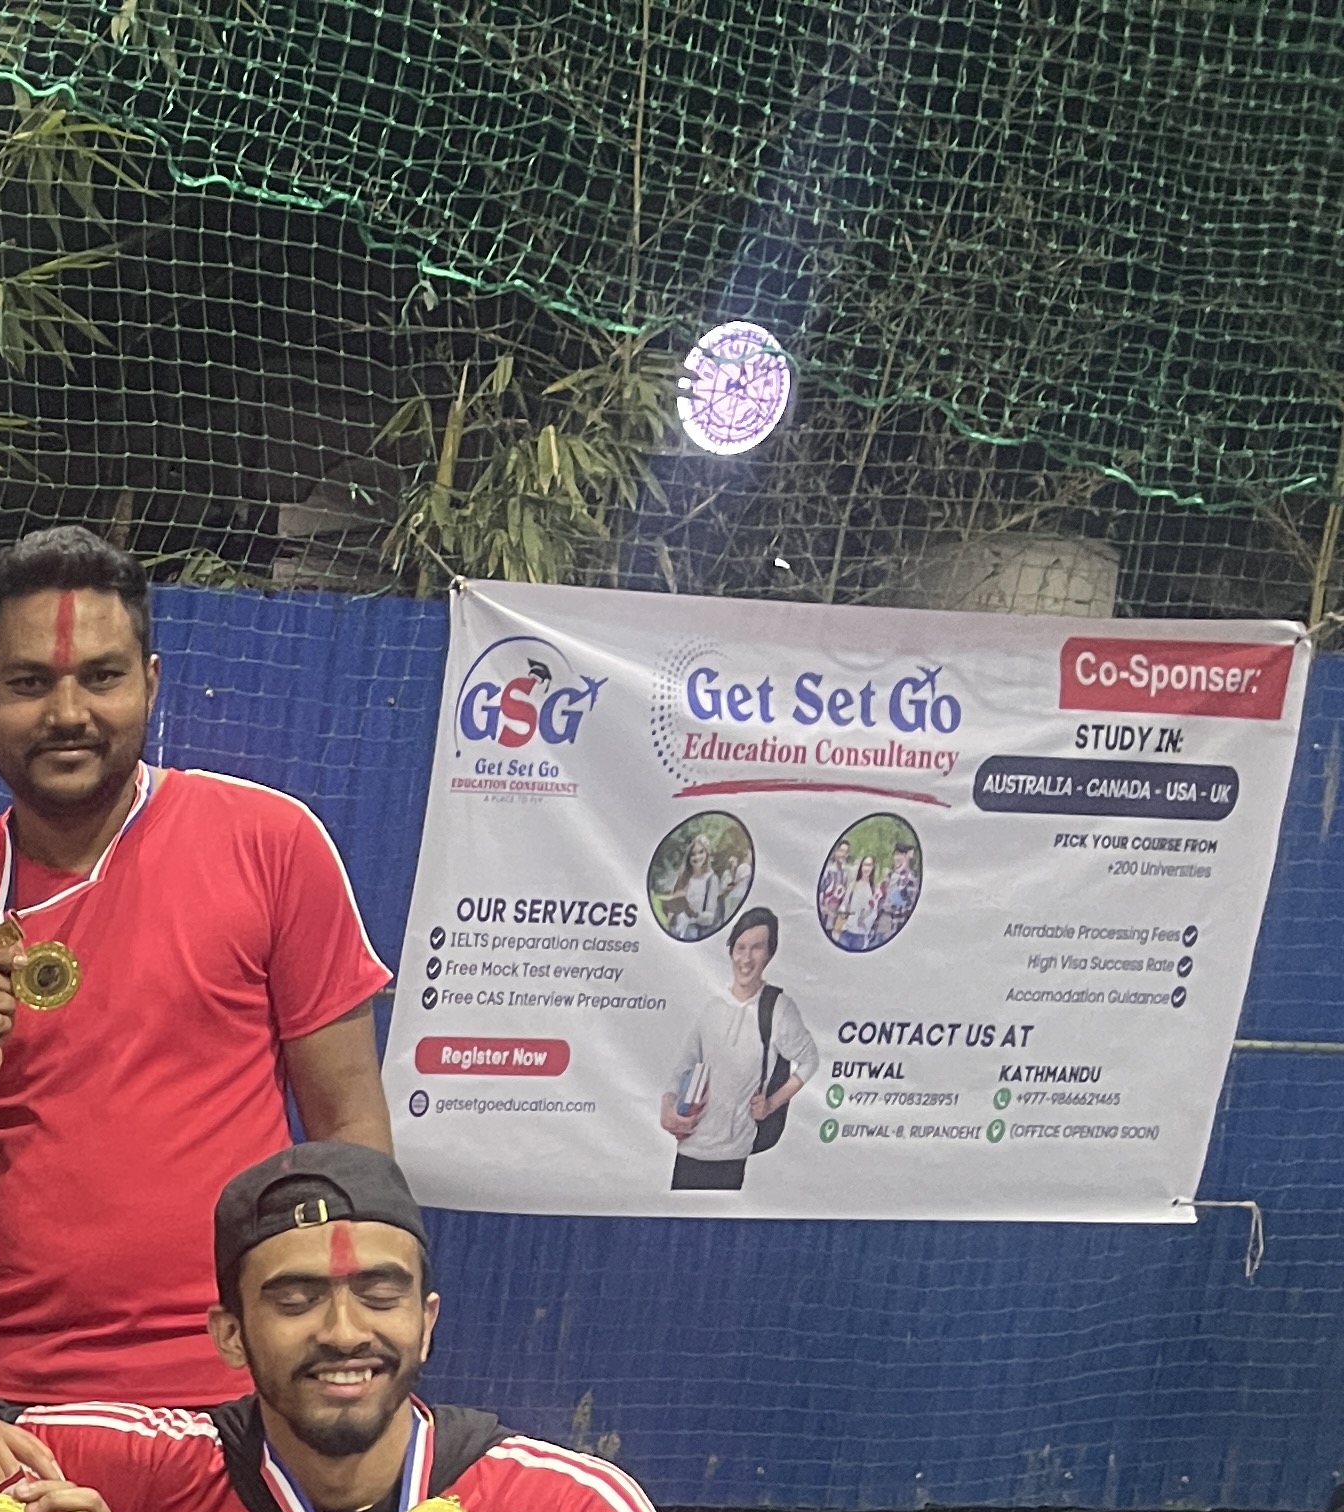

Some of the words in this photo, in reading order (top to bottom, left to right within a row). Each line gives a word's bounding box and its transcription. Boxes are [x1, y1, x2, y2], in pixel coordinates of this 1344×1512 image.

[1075, 651, 1261, 697] Co-Sponser:
[687, 667, 775, 724] Get
[792, 672, 878, 728] Set
[889, 674, 962, 734] Go
[459, 675, 590, 749] GSG
[1075, 724, 1153, 752] STUDY
[1154, 728, 1184, 753] IN:
[683, 733, 807, 764] Education
[815, 738, 959, 777] Consultancy
[475, 758, 502, 776] Get
[507, 759, 534, 777] Set
[538, 761, 560, 778] Go
[451, 778, 507, 790] EDUCATION
[982, 774, 1072, 797] AUSTRALIA
[1086, 778, 1151, 800] CANADA
[1166, 782, 1197, 802] USA
[1210, 783, 1233, 804] UK
[1054, 833, 1087, 850] PICK
[1092, 835, 1128, 851] YOUR
[1132, 837, 1181, 853] COURSE
[1184, 839, 1218, 854] FROM
[1107, 861, 1139, 877] +200
[456, 897, 506, 924] OUR
[513, 899, 638, 928] SERVICES
[450, 932, 489, 949] IELTS
[492, 934, 579, 952] preparation
[583, 937, 639, 954] classes
[1004, 924, 1075, 941] Affordable
[1078, 926, 1148, 945] Processing
[1151, 927, 1181, 943] Fees
[446, 960, 477, 977] Free
[481, 962, 518, 979] Mock
[522, 964, 551, 979] Test
[554, 966, 623, 983] everyday
[1028, 955, 1057, 973] High
[1061, 955, 1087, 971] Visa
[1090, 956, 1143, 972] Success
[1146, 958, 1174, 972] Rate
[441, 989, 472, 1006] Free
[477, 991, 504, 1007] CAS
[509, 992, 574, 1008] Interview
[578, 993, 666, 1011] Preparation
[1006, 988, 1104, 1004] Accomodation
[837, 1021, 961, 1047] CONTACT
[965, 1024, 996, 1048] US
[1001, 1025, 1034, 1049] AT
[441, 1046, 509, 1069] Register
[513, 1048, 547, 1067] Now
[832, 1061, 905, 1080] BUTWAL
[999, 1065, 1102, 1083] KATHMANDU
[435, 1097, 595, 1115] getsetgoeducation.com
[910, 1125, 982, 1140] RUPANDEHI
[1010, 1123, 1060, 1139] (OFFICE
[1121, 1125, 1160, 1141] SOON)
